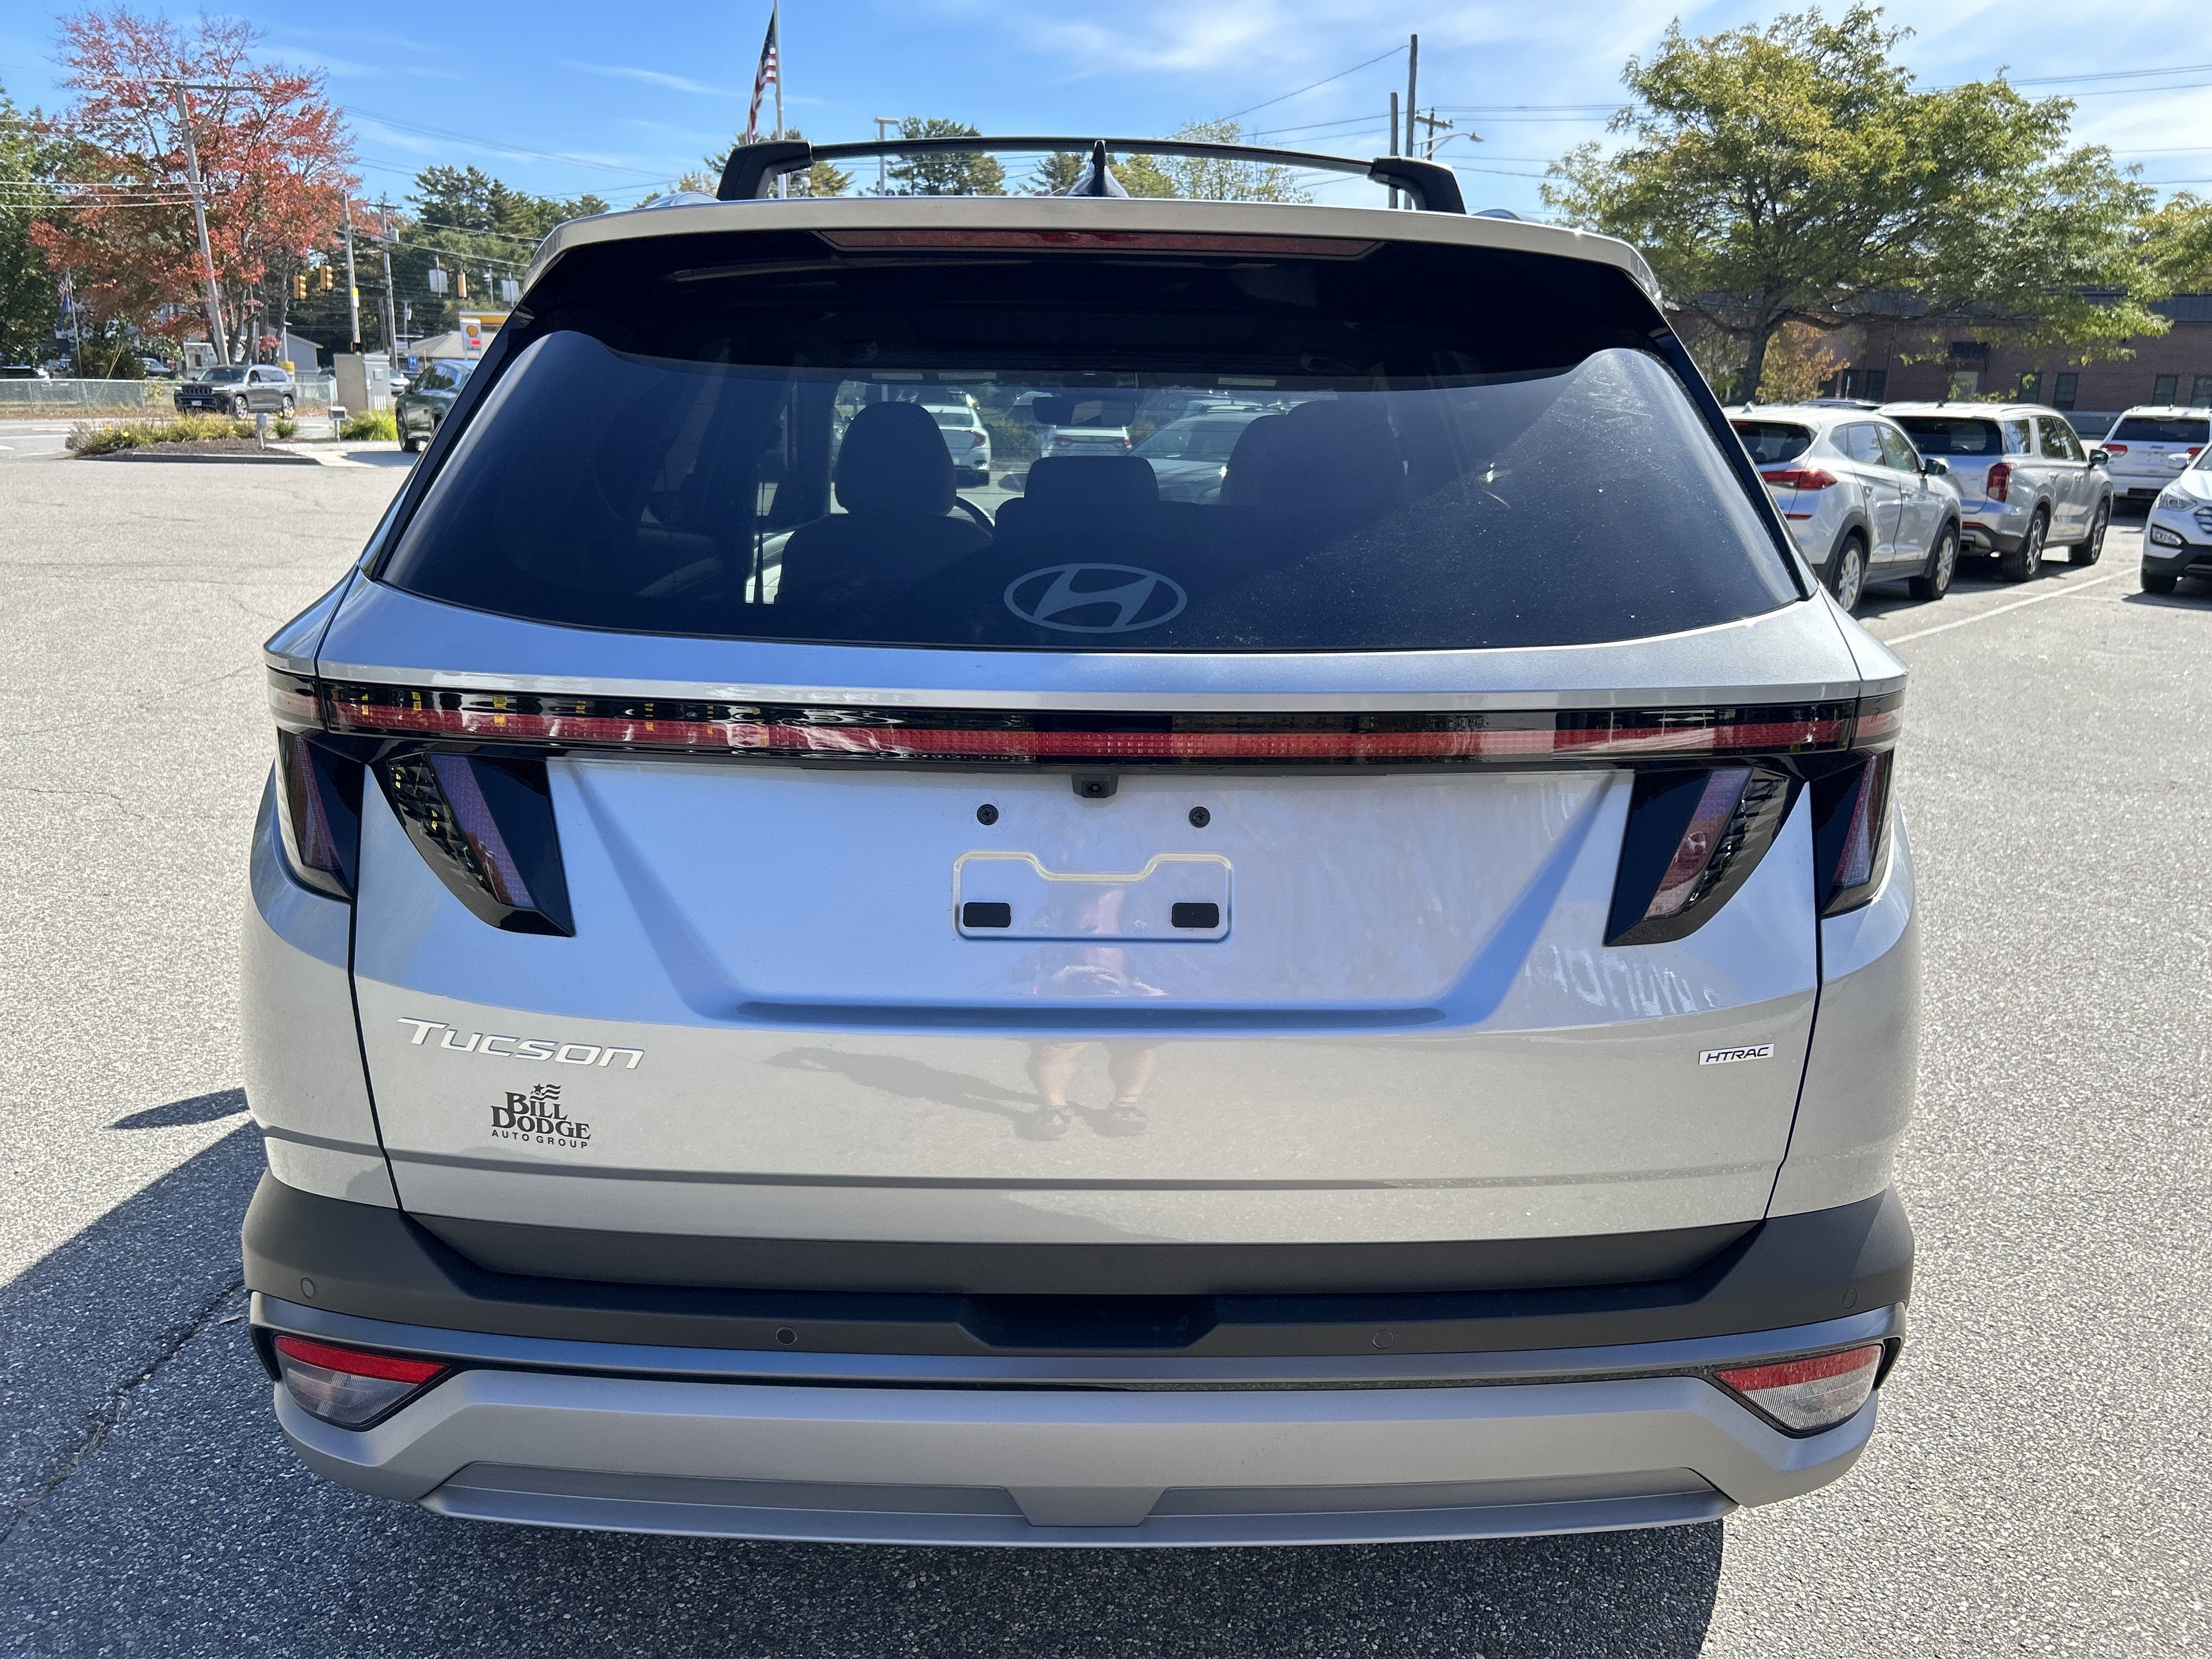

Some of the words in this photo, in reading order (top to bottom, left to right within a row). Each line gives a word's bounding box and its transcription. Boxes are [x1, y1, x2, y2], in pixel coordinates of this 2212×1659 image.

[1706, 1047, 1769, 1063] HTRAC
[505, 1092, 568, 1120] BILL
[490, 1105, 591, 1140] DODGE
[492, 1129, 530, 1142] AUTO
[536, 1136, 588, 1149] GROUP
